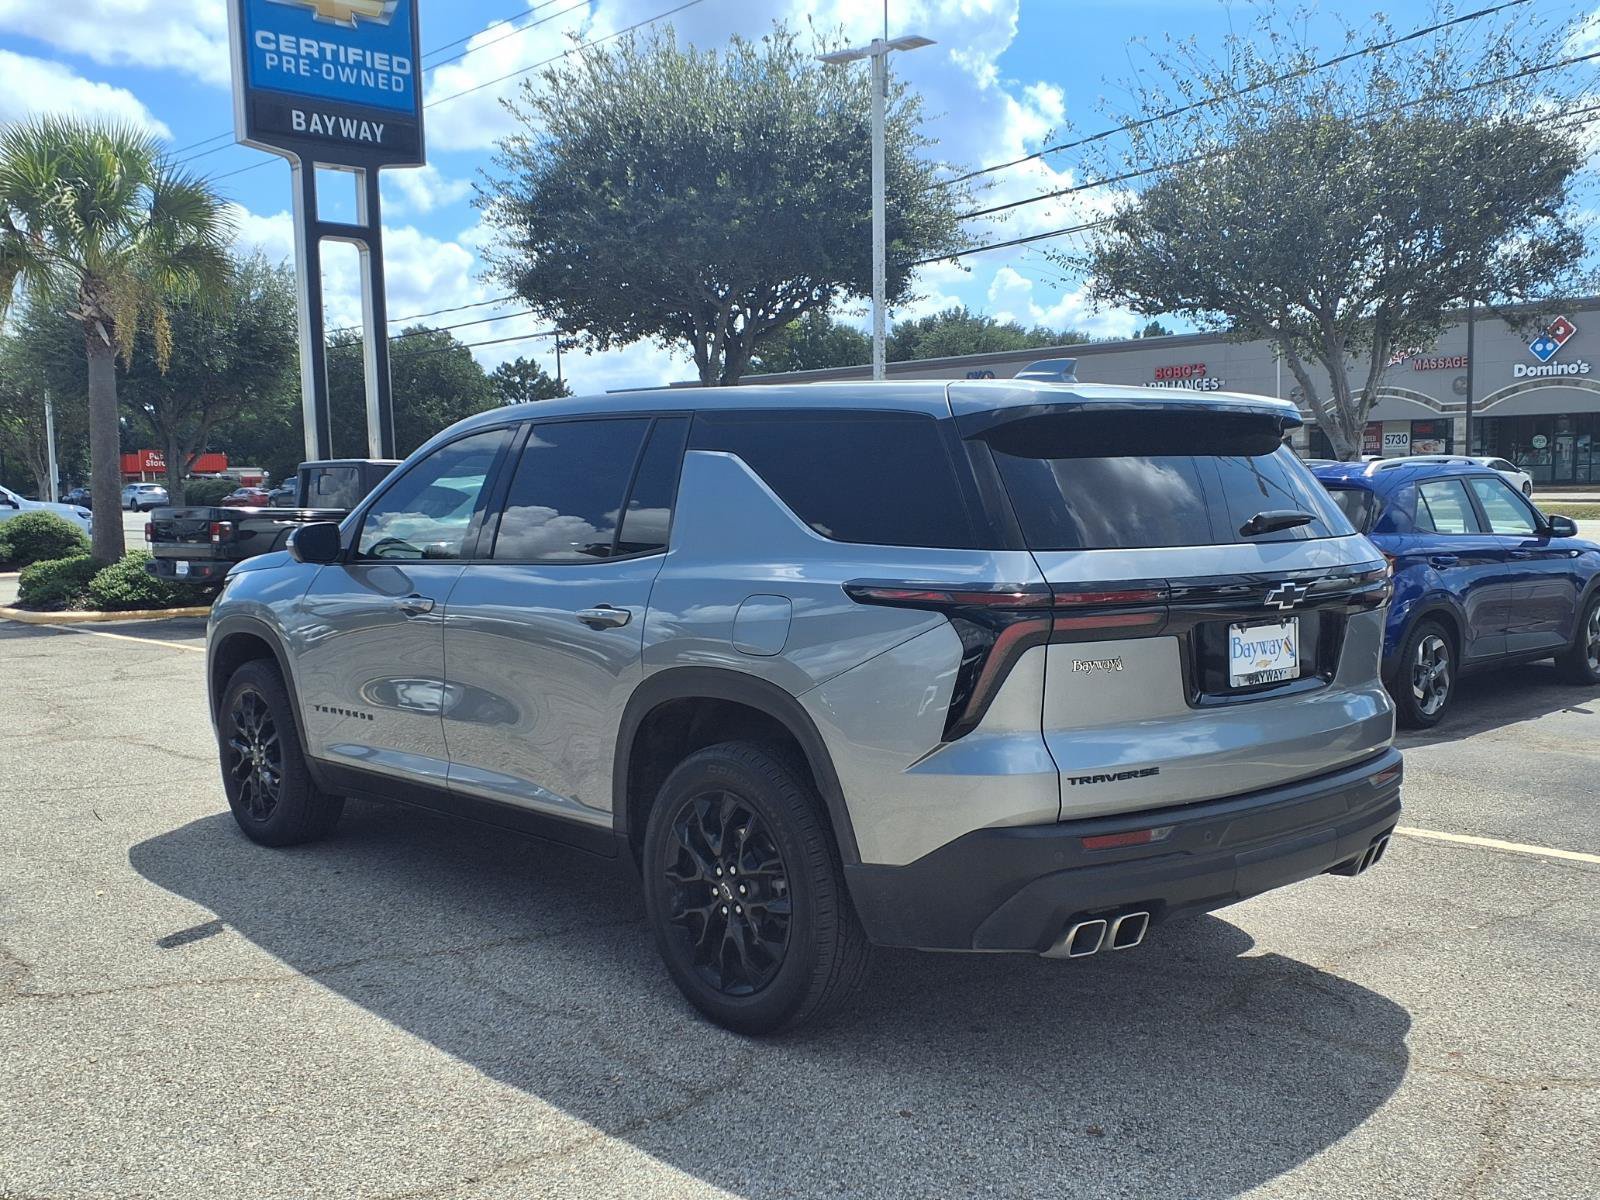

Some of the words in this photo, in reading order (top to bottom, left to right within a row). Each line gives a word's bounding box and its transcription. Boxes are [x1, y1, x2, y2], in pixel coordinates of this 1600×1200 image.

[255, 30, 411, 75] CERTIFIED
[265, 53, 404, 92] PRE-OWNED
[291, 110, 384, 143] BAYWAY
[1154, 363, 1206, 380] BOBO'S
[1413, 355, 1468, 371] MASSAGE
[1513, 360, 1591, 378] Domino's
[1384, 434, 1408, 445] 5730
[1231, 636, 1284, 665] Bayway
[1071, 659, 1117, 675] Bayway
[314, 705, 373, 720] TRAVERSE
[1066, 766, 1160, 786] TRAVERSE
